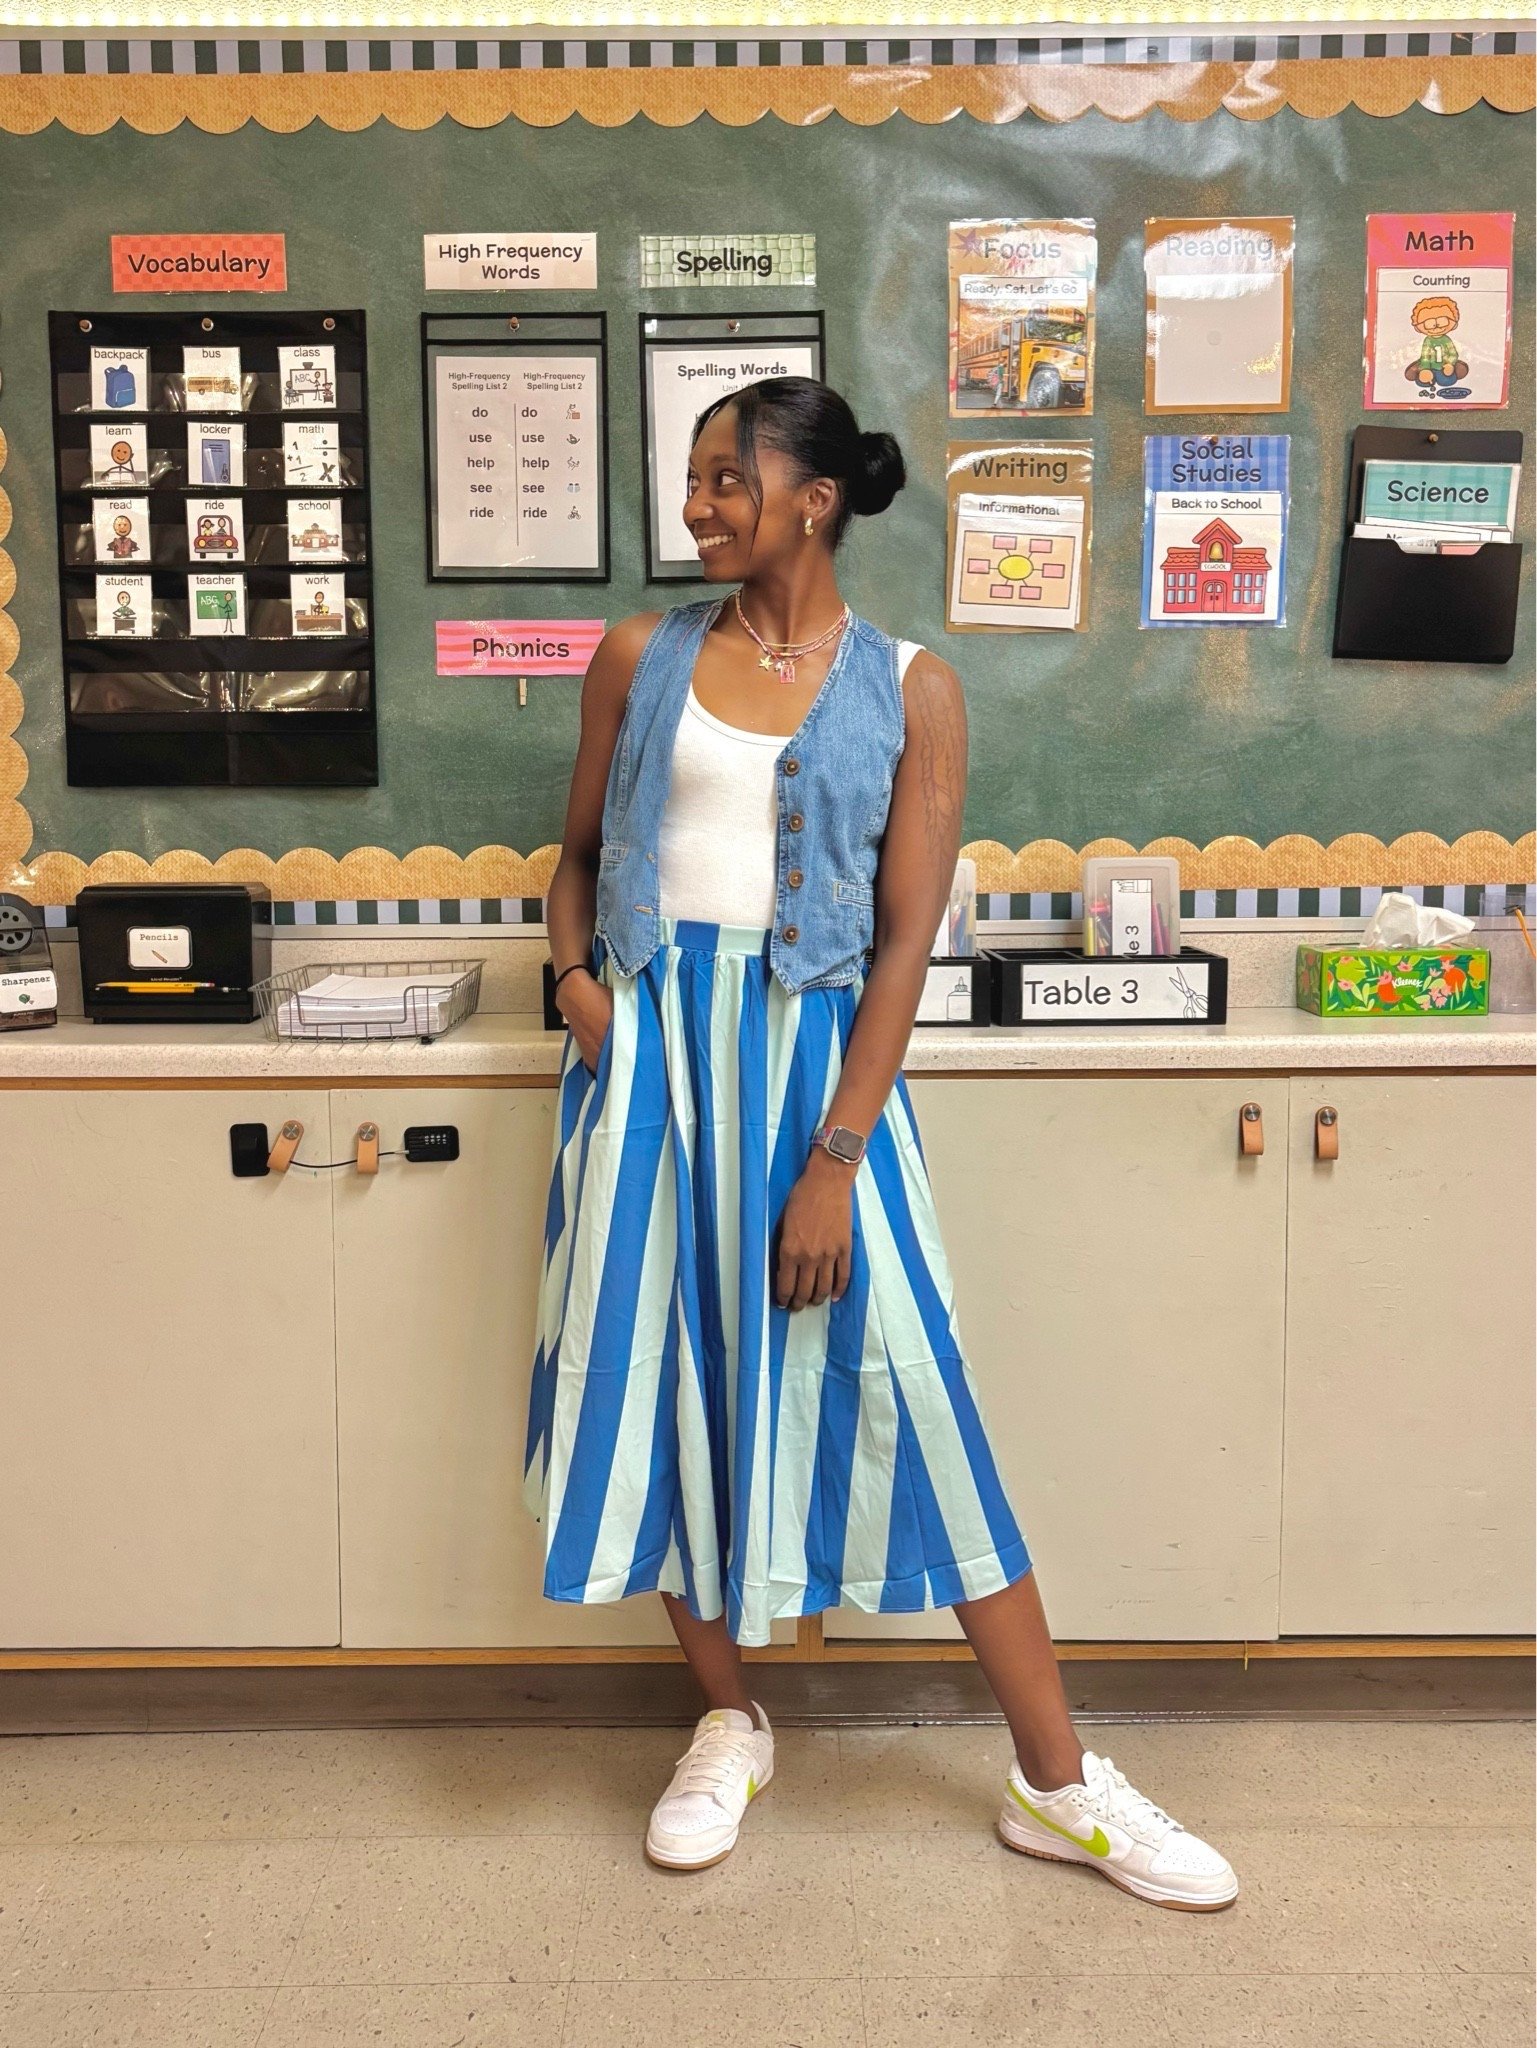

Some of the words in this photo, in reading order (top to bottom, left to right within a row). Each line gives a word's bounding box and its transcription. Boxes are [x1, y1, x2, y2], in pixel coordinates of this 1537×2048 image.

[1405, 230, 1474, 251] Math
[439, 244, 481, 263] High
[486, 244, 583, 263] Frequency
[984, 238, 1061, 260] Focus
[1166, 235, 1273, 261] Reading
[128, 249, 270, 279] Vocabulary
[677, 248, 773, 278] Spelling
[482, 265, 541, 280] Words
[1412, 274, 1471, 288] Counting
[1030, 283, 1059, 294] Let's
[1061, 284, 1078, 294] Go
[94, 349, 144, 361] backpack
[202, 348, 221, 359] bus
[293, 347, 321, 358] class
[1432, 345, 1442, 363] 1
[677, 363, 737, 380] Spelling
[741, 362, 788, 375] Words
[295, 373, 310, 384] ABC
[448, 372, 511, 382] High-Frequency
[523, 372, 586, 382] High-Frequency
[452, 382, 484, 392] Spelling
[486, 382, 501, 390] List
[502, 382, 508, 390] 2
[527, 382, 559, 392] Spelling
[561, 382, 576, 390] List
[577, 382, 583, 390] 2
[722, 384, 739, 392] Unit
[472, 406, 489, 418] do
[521, 406, 538, 418] do
[105, 426, 132, 436] learn
[200, 424, 231, 435] locker
[298, 424, 325, 434] math
[469, 433, 492, 444] use
[522, 433, 545, 444] use
[1181, 437, 1254, 460] Social
[467, 456, 495, 470] help
[522, 456, 550, 470] help
[973, 457, 1068, 484] Writing
[1173, 463, 1262, 483] Studies
[470, 483, 493, 493] see
[522, 483, 545, 493] see
[1387, 480, 1489, 503] Science
[109, 500, 132, 510] read
[204, 500, 225, 510] ride
[298, 500, 331, 511] school
[978, 501, 1060, 517] Informational
[1172, 498, 1201, 509] Back
[1203, 499, 1218, 509] to
[1221, 498, 1262, 510] School
[469, 507, 494, 518] ride
[523, 507, 548, 518] ride
[105, 576, 144, 586] student
[196, 575, 235, 585] teacher
[305, 575, 330, 585] work
[472, 637, 570, 658] Phonics
[1125, 925, 1139, 935] 3
[140, 933, 179, 941] Pencils
[1, 976, 51, 986] Sharpener
[1392, 976, 1423, 989] Kleenex
[1024, 975, 1111, 1005] Table
[1121, 979, 1139, 1004] 3
